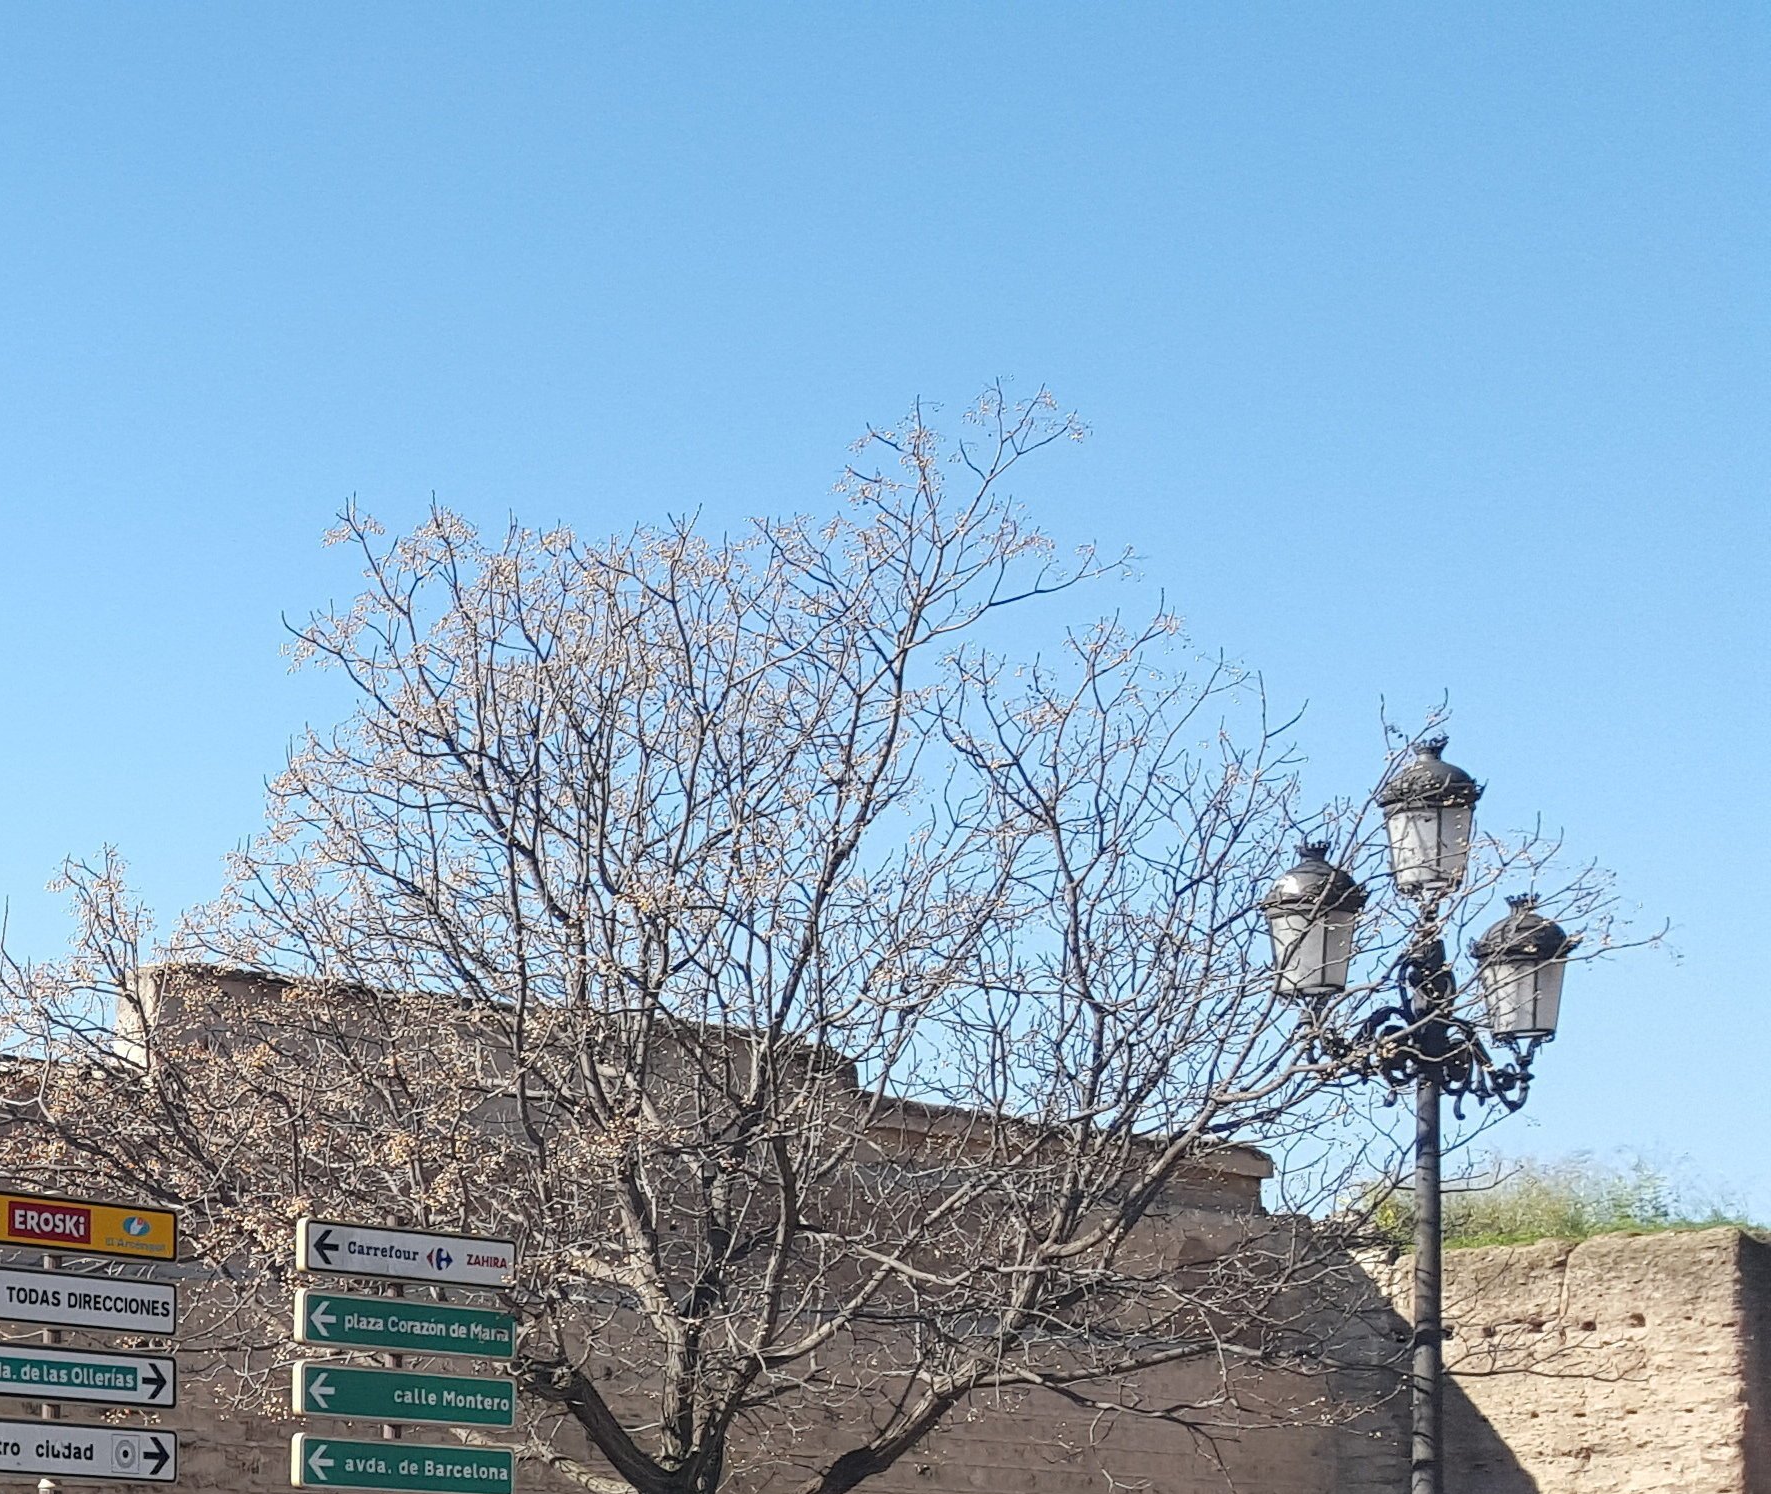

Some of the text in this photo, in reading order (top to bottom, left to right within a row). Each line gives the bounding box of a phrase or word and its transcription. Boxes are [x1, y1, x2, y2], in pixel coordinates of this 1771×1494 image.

[347, 1241, 508, 1269] Carrefour ZAHIRA
[6, 1287, 170, 1317] TODAS DIRECCIONES
[344, 1312, 384, 1332] plaza
[388, 1316, 446, 1337] Corazón
[450, 1321, 467, 1339] de
[21, 1364, 40, 1381] de
[43, 1366, 68, 1383] las
[71, 1367, 135, 1388] Ollerías
[394, 1389, 510, 1411] calle Montero
[35, 1440, 94, 1461] ciudad
[345, 1457, 508, 1481] avda. de Barcelona
